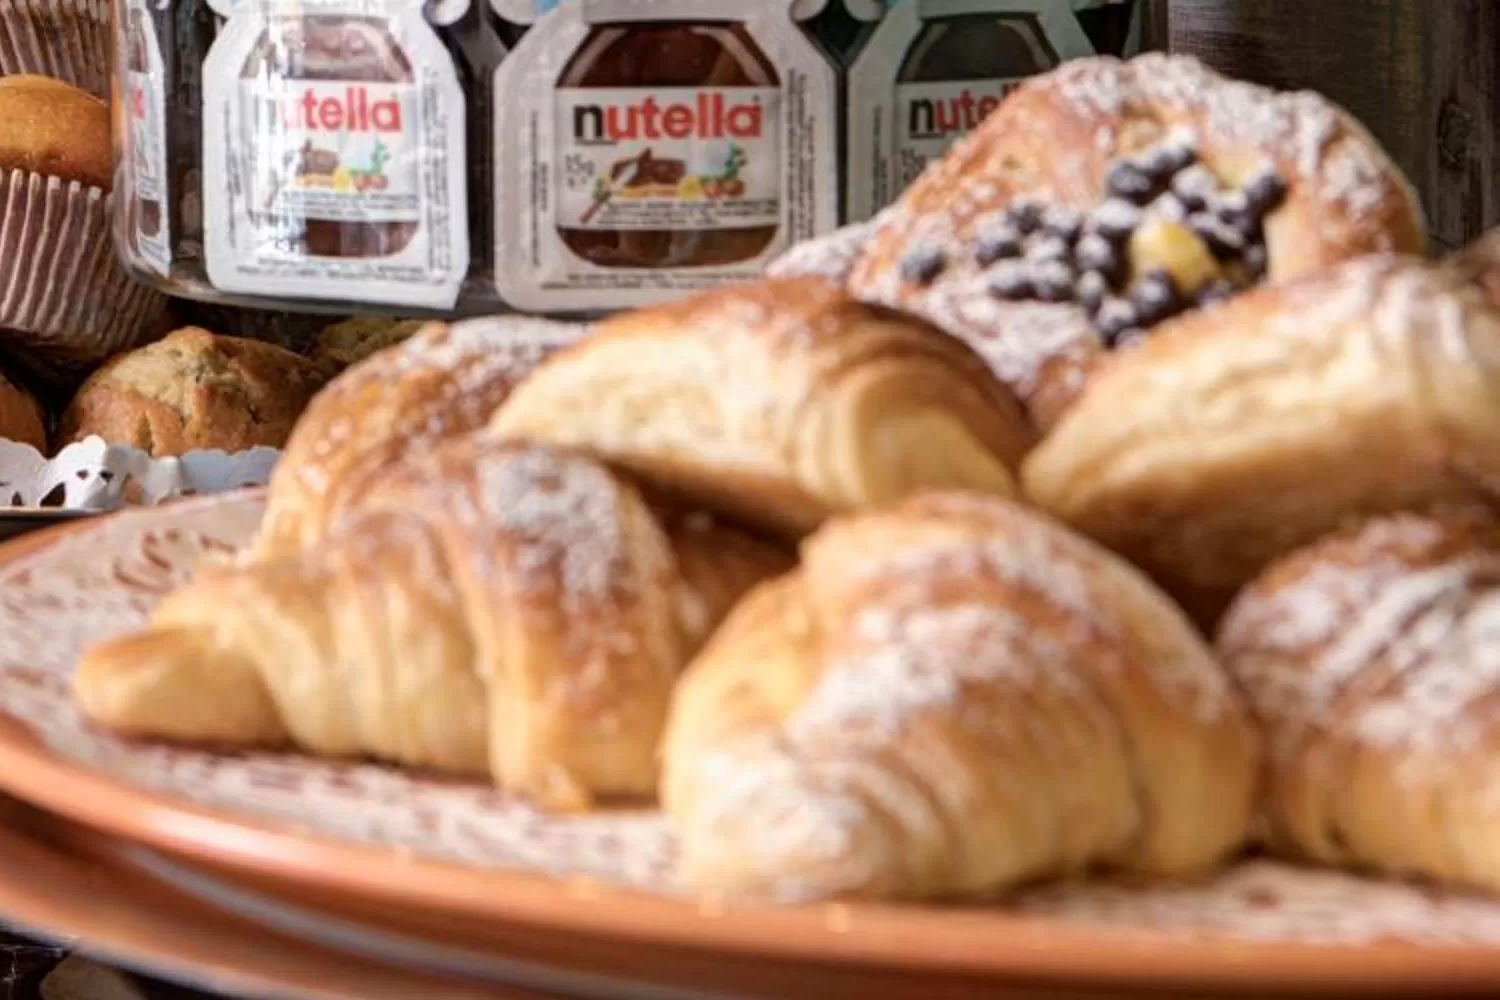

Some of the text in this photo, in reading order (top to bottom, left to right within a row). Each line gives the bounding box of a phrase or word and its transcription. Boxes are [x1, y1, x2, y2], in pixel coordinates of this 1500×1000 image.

[282, 87, 402, 133] tella
[573, 93, 762, 140] nutella
[909, 82, 1021, 133] nute
